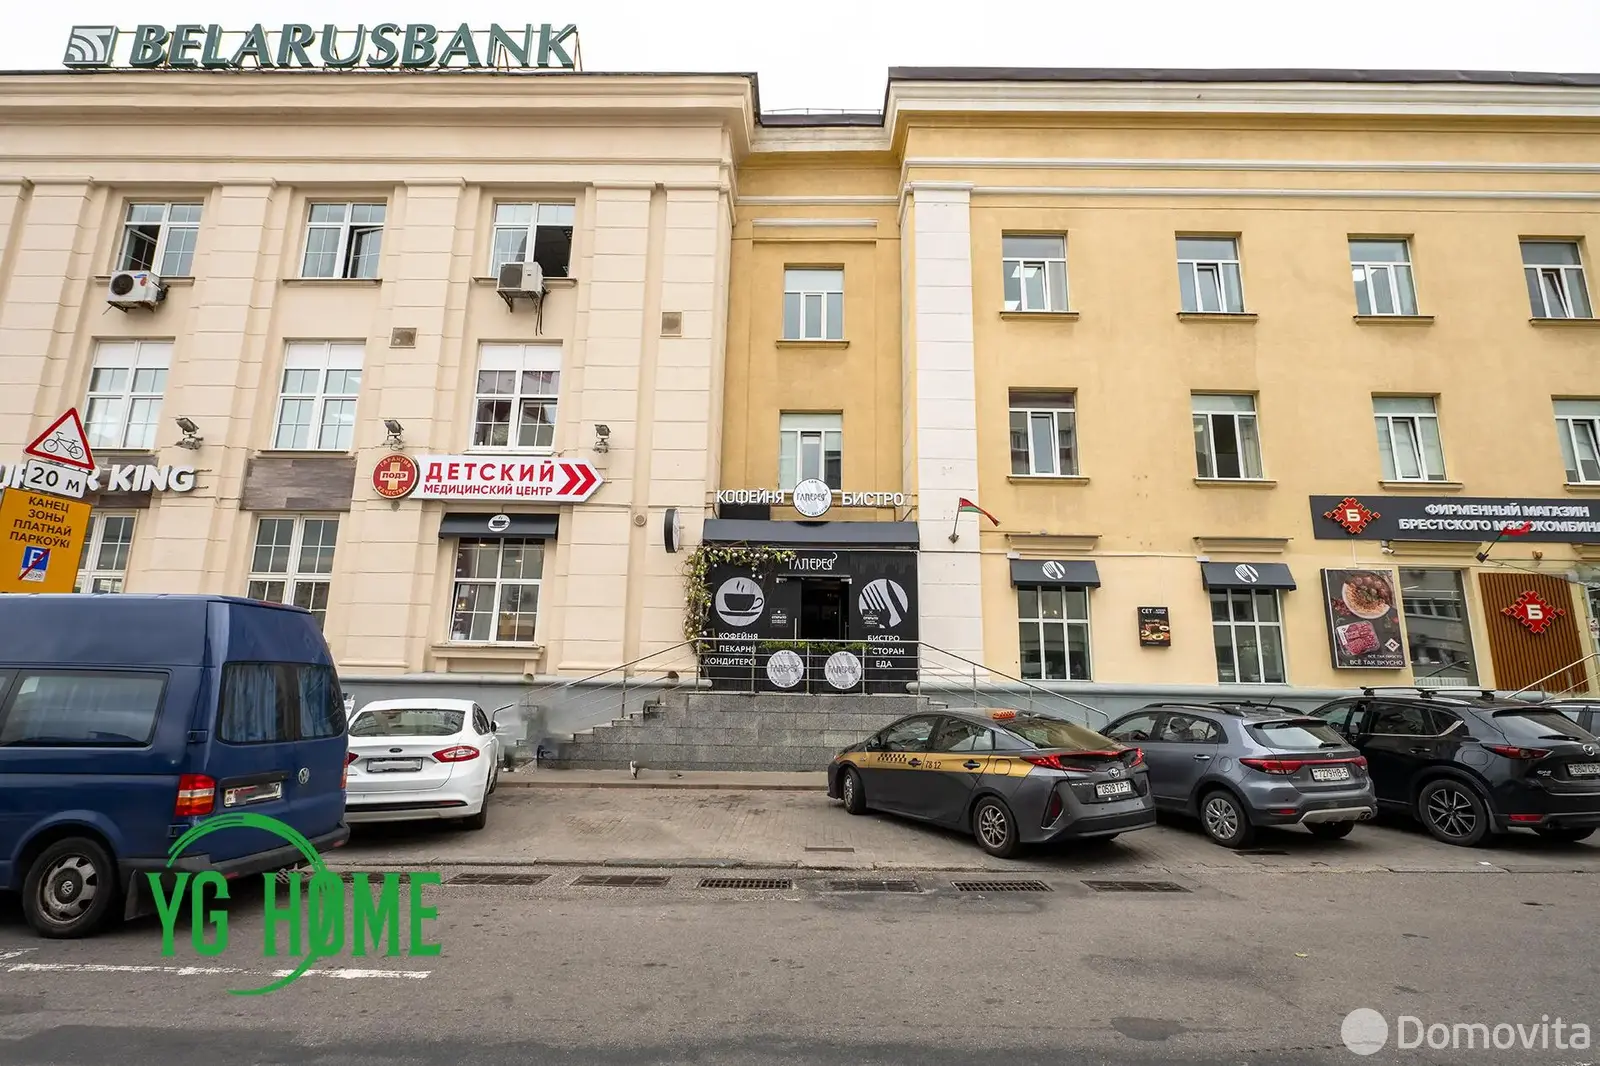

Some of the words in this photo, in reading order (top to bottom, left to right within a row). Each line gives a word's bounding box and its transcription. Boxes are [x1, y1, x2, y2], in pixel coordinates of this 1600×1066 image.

[129, 23, 577, 69] BELARUSBANK
[30, 467, 59, 487] 20
[108, 465, 196, 492] KING
[425, 460, 554, 483] ДЕТСКИЙ
[423, 483, 513, 496] МЕДИЦИНСКИЙ
[516, 485, 553, 497] ЦЕНТР
[716, 488, 784, 505] КОФЕЙНЯ
[28, 496, 70, 514] КАНЕЦ
[842, 492, 904, 506] БИСТРО
[28, 508, 65, 524] ЗОНЫ
[1345, 508, 1360, 522] Б
[1424, 502, 1521, 516] ФИРМЕННЫЙ
[1522, 506, 1590, 517] МАГАЗИН
[13, 518, 72, 537] ПЛАТНАЙ
[1398, 519, 1492, 530] БРЕСТСКОГО
[9, 531, 70, 549] ПАРКОЎКІ
[1527, 605, 1543, 620] Б
[718, 632, 758, 640] КОФЕЙНЯ
[704, 657, 757, 666] КОНДИТЕРС
[875, 660, 893, 668] ЕДА
